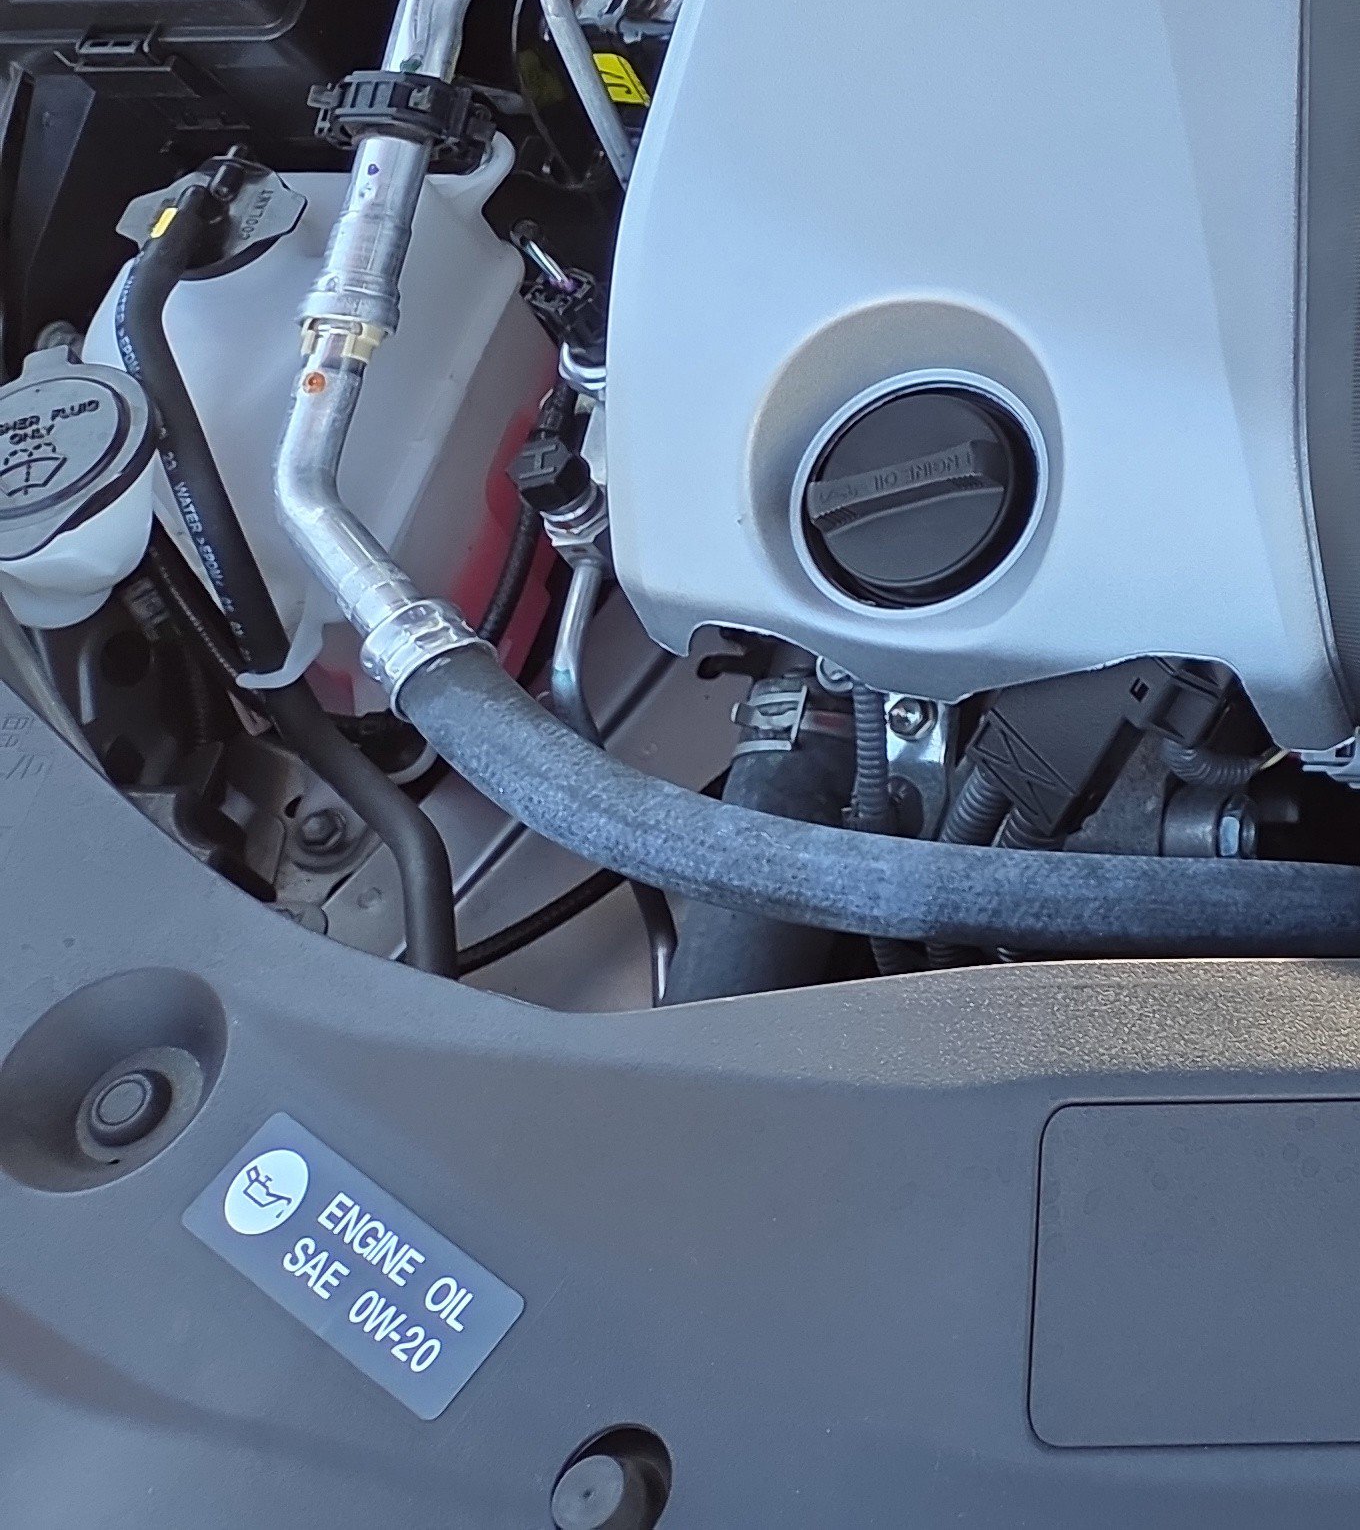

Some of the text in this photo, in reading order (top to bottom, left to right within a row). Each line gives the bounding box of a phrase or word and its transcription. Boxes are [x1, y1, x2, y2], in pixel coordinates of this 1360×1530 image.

[240, 190, 274, 241] COOLANT
[9, 424, 55, 445] ONLY
[50, 400, 100, 423] FLUID
[173, 482, 203, 535] WATER
[318, 1192, 473, 1332] ENGINE OIL
[283, 1237, 441, 1372] SAE 0W-20
